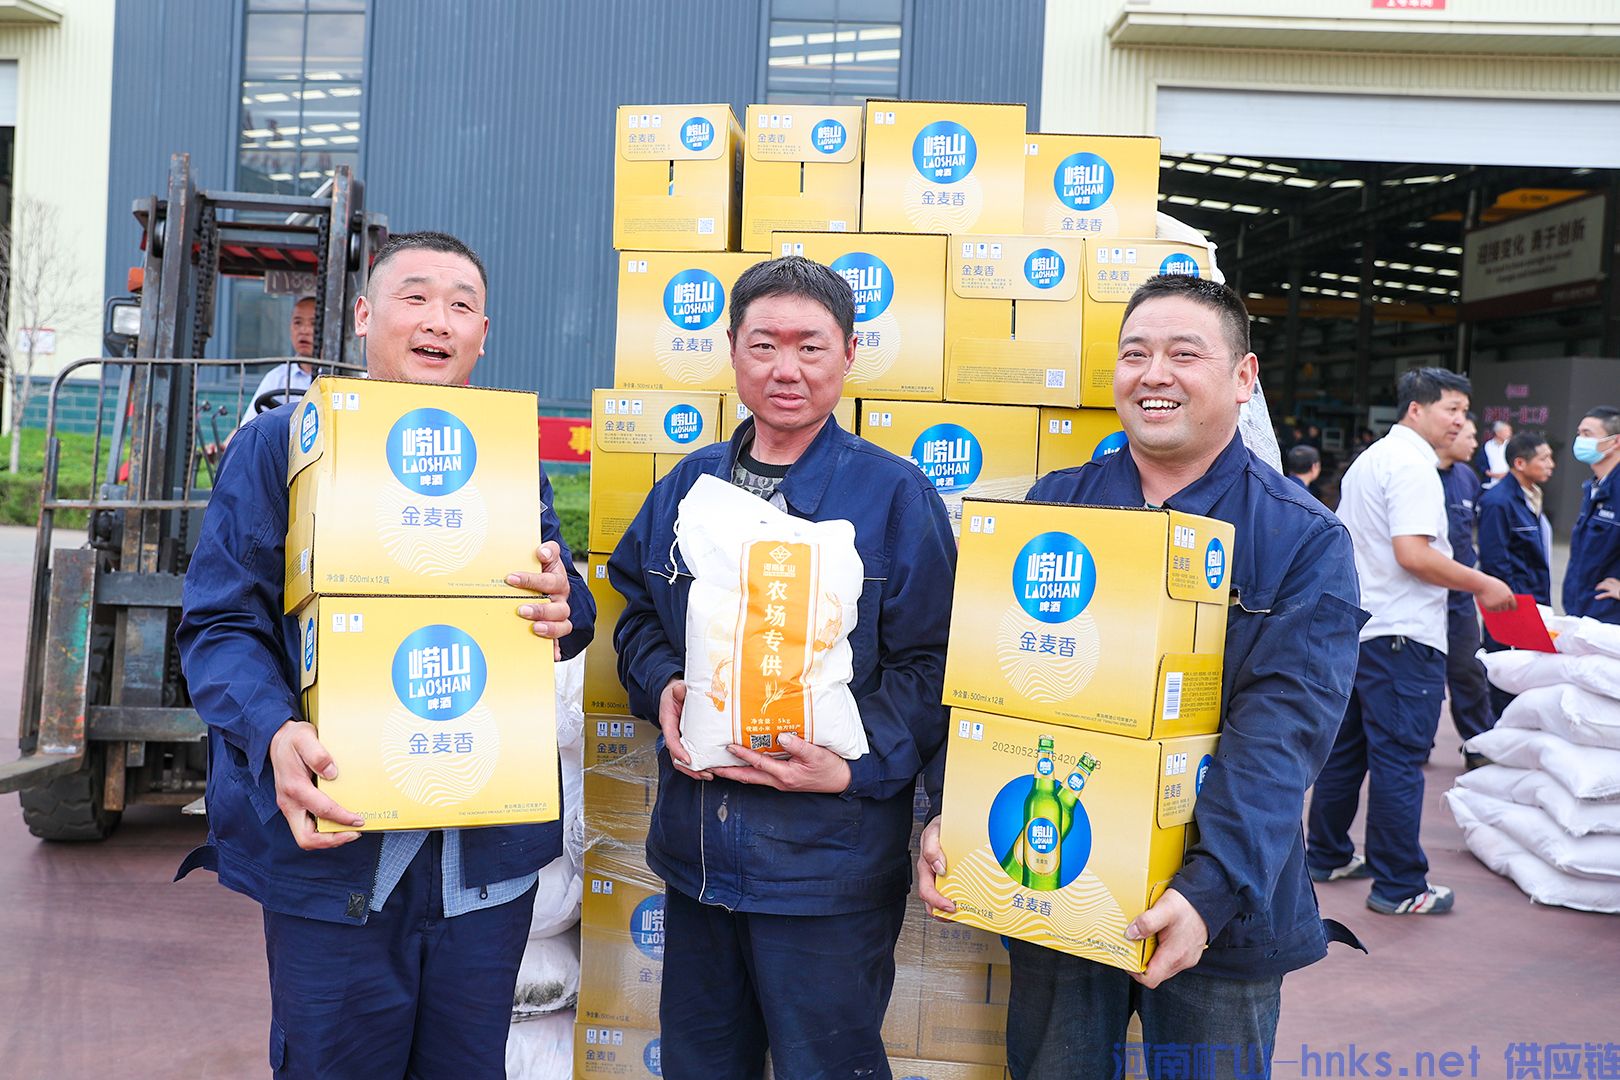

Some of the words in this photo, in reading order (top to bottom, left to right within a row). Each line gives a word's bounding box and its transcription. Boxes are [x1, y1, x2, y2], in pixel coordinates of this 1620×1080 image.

[924, 134, 966, 156] 崂山
[924, 154, 966, 169] LAOSHAN
[935, 168, 952, 177] 啤酒
[1064, 163, 1104, 184] 崂山
[1064, 183, 1104, 197] LAOSHAN
[921, 191, 965, 206] 金麦香
[1061, 217, 1102, 232] 金麦香
[962, 264, 994, 276] 金麦香
[1032, 256, 1060, 270] 崂山
[1032, 269, 1058, 279] LAOSHAN
[1097, 270, 1130, 281] 金麦香
[674, 280, 715, 303] 崂山
[854, 290, 881, 303] SHAN
[673, 302, 714, 316] LAOSHAN
[671, 337, 713, 352] 金麦香
[604, 420, 635, 432] 金麦香
[671, 412, 698, 426] 崂山
[670, 424, 698, 434] LAOSHAN
[403, 426, 462, 456] 崂山
[923, 438, 970, 463] 崂山
[402, 456, 462, 474] LAOSHAN
[420, 474, 444, 486] 啤酒
[401, 506, 463, 528] 金麦香
[1026, 551, 1083, 582] 崂山
[1025, 582, 1081, 600] LAOSHAN
[1039, 601, 1061, 612] 啤酒
[760, 580, 788, 677] 农场专供
[1019, 632, 1076, 658] 金麦香
[408, 643, 470, 680] 崂山
[408, 675, 470, 699] LAOSHAN
[428, 696, 452, 710] 啤酒
[408, 732, 474, 755] 金麦香
[597, 743, 627, 754] 金麦香
[992, 742, 1039, 759] 20230523
[1012, 894, 1052, 917] 金麦香
